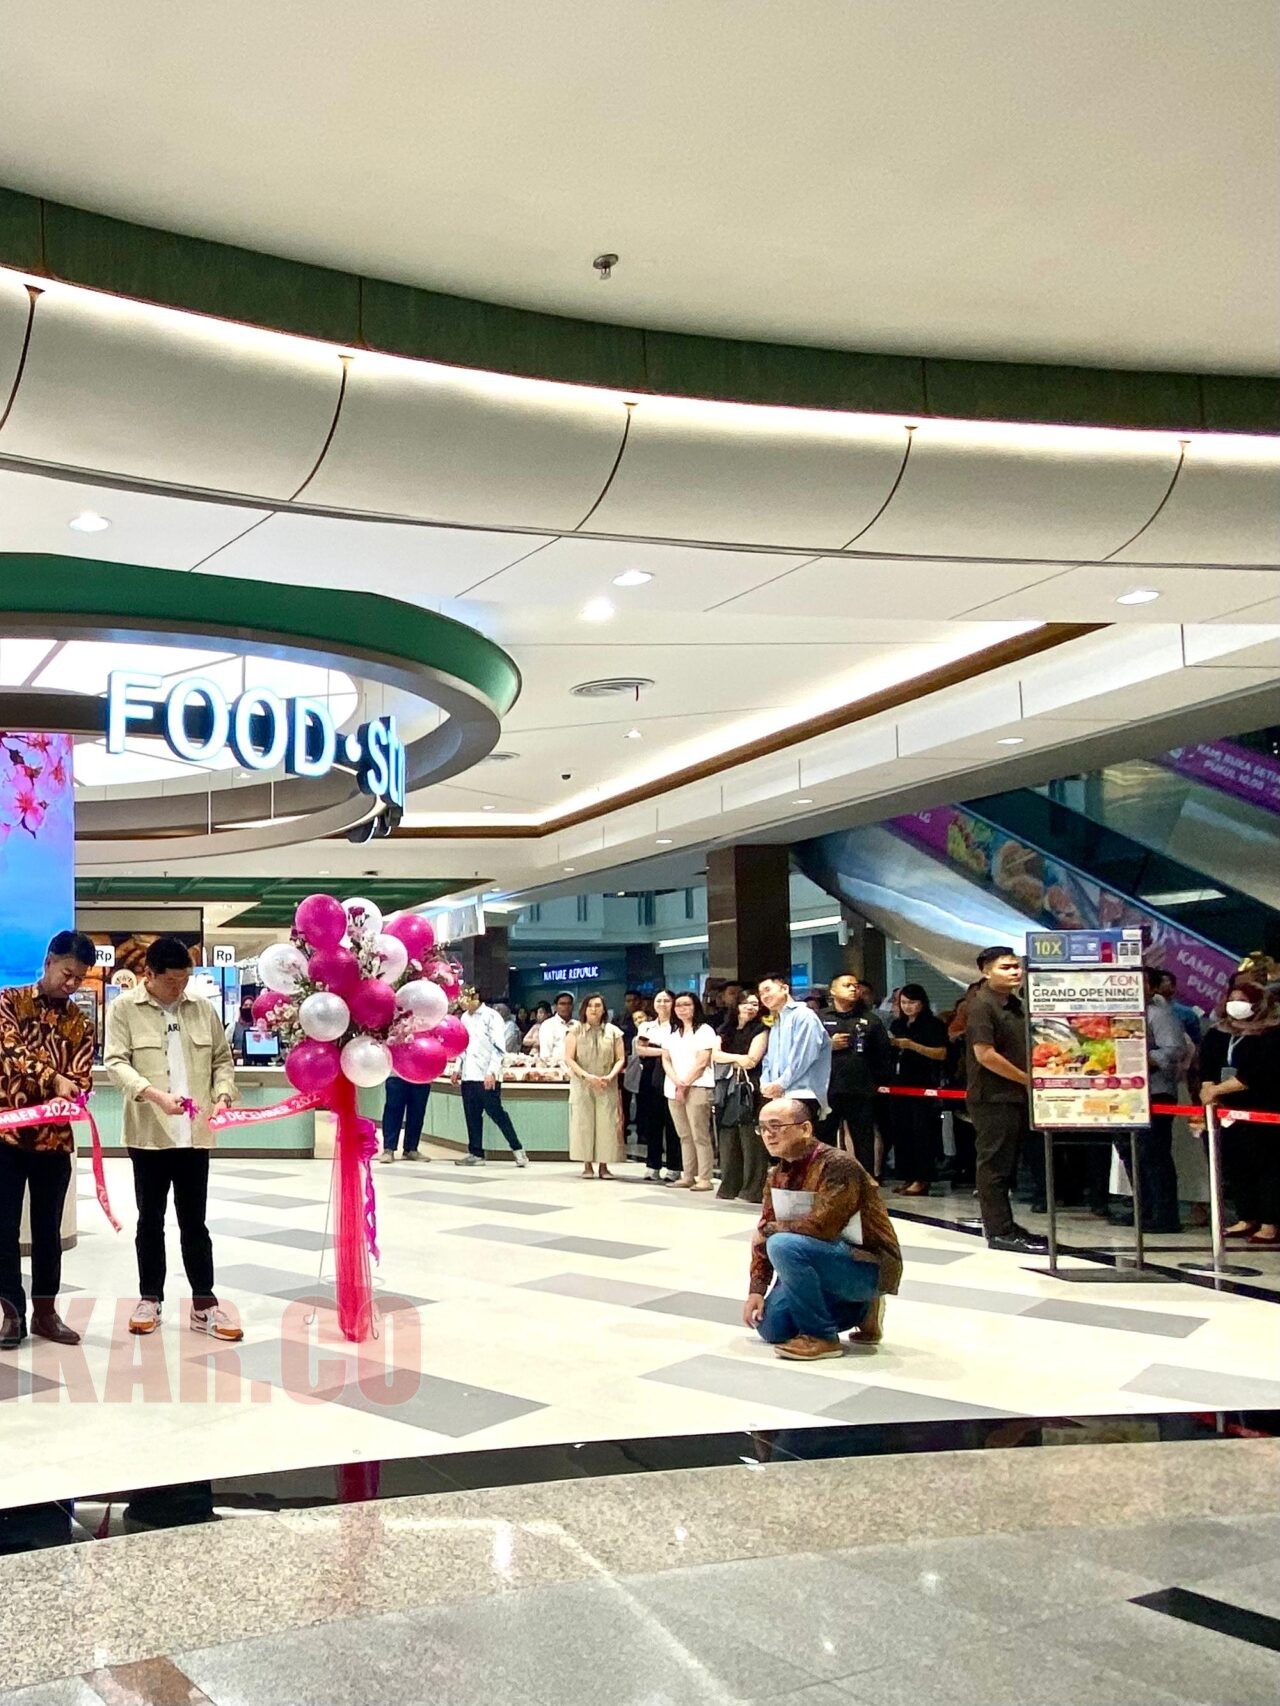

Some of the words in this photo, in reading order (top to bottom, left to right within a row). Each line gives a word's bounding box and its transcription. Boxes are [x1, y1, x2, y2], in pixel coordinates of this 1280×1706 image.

[106, 670, 336, 778] FOOD
[95, 950, 112, 962] Rp
[216, 950, 232, 962] Rp
[1177, 949, 1214, 978] KAMI
[543, 969, 567, 981] NATURE
[568, 966, 599, 980] REPUBLIC
[1032, 988, 1076, 998] GRAND
[1078, 987, 1139, 998] OPENING!
[41, 1103, 81, 1117] 2025
[225, 1105, 294, 1121] DECEMBER
